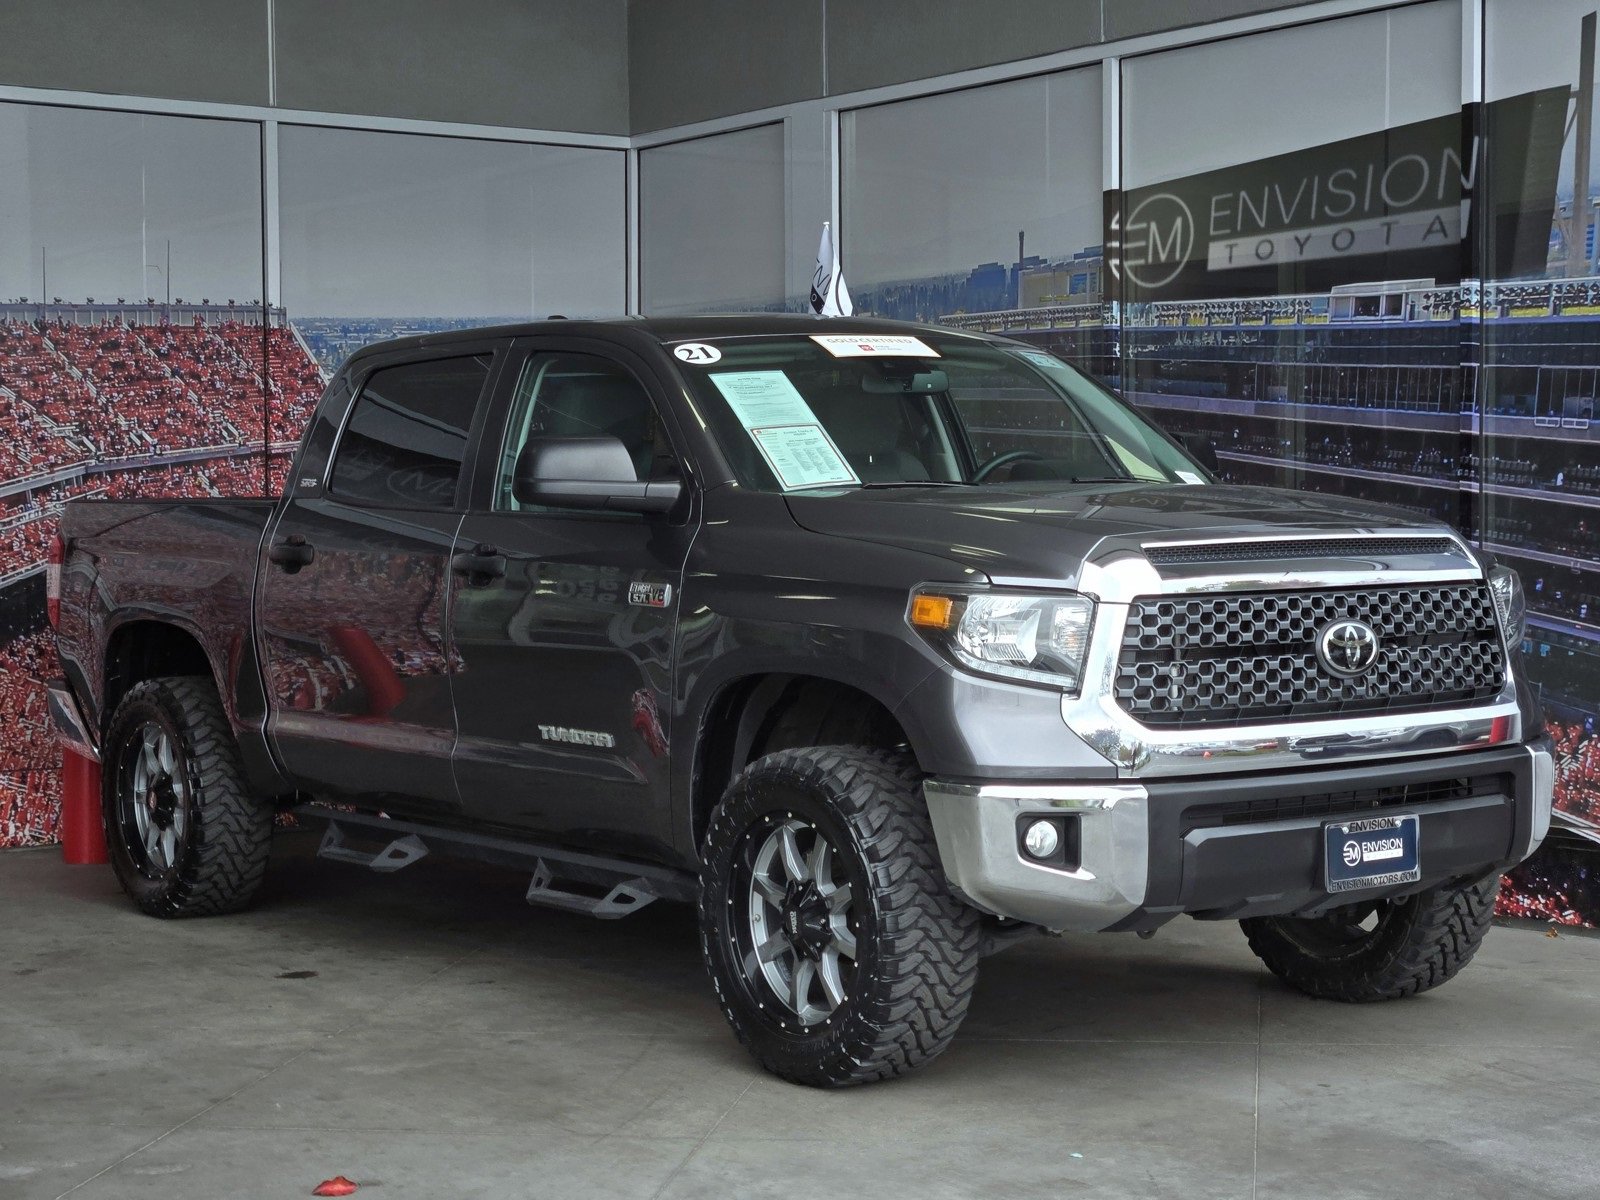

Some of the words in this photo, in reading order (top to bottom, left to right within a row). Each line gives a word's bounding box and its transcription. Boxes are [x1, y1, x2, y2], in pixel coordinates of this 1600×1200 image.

[1209, 137, 1478, 236] ENVISION
[1225, 214, 1449, 264] TOYOTA
[678, 346, 714, 361] 21
[538, 725, 615, 748] TUNDRA
[1349, 818, 1395, 832] ENVISION
[1362, 838, 1403, 853] ENVISION
[1330, 871, 1418, 891] ENVISIONMOTORS.COM
